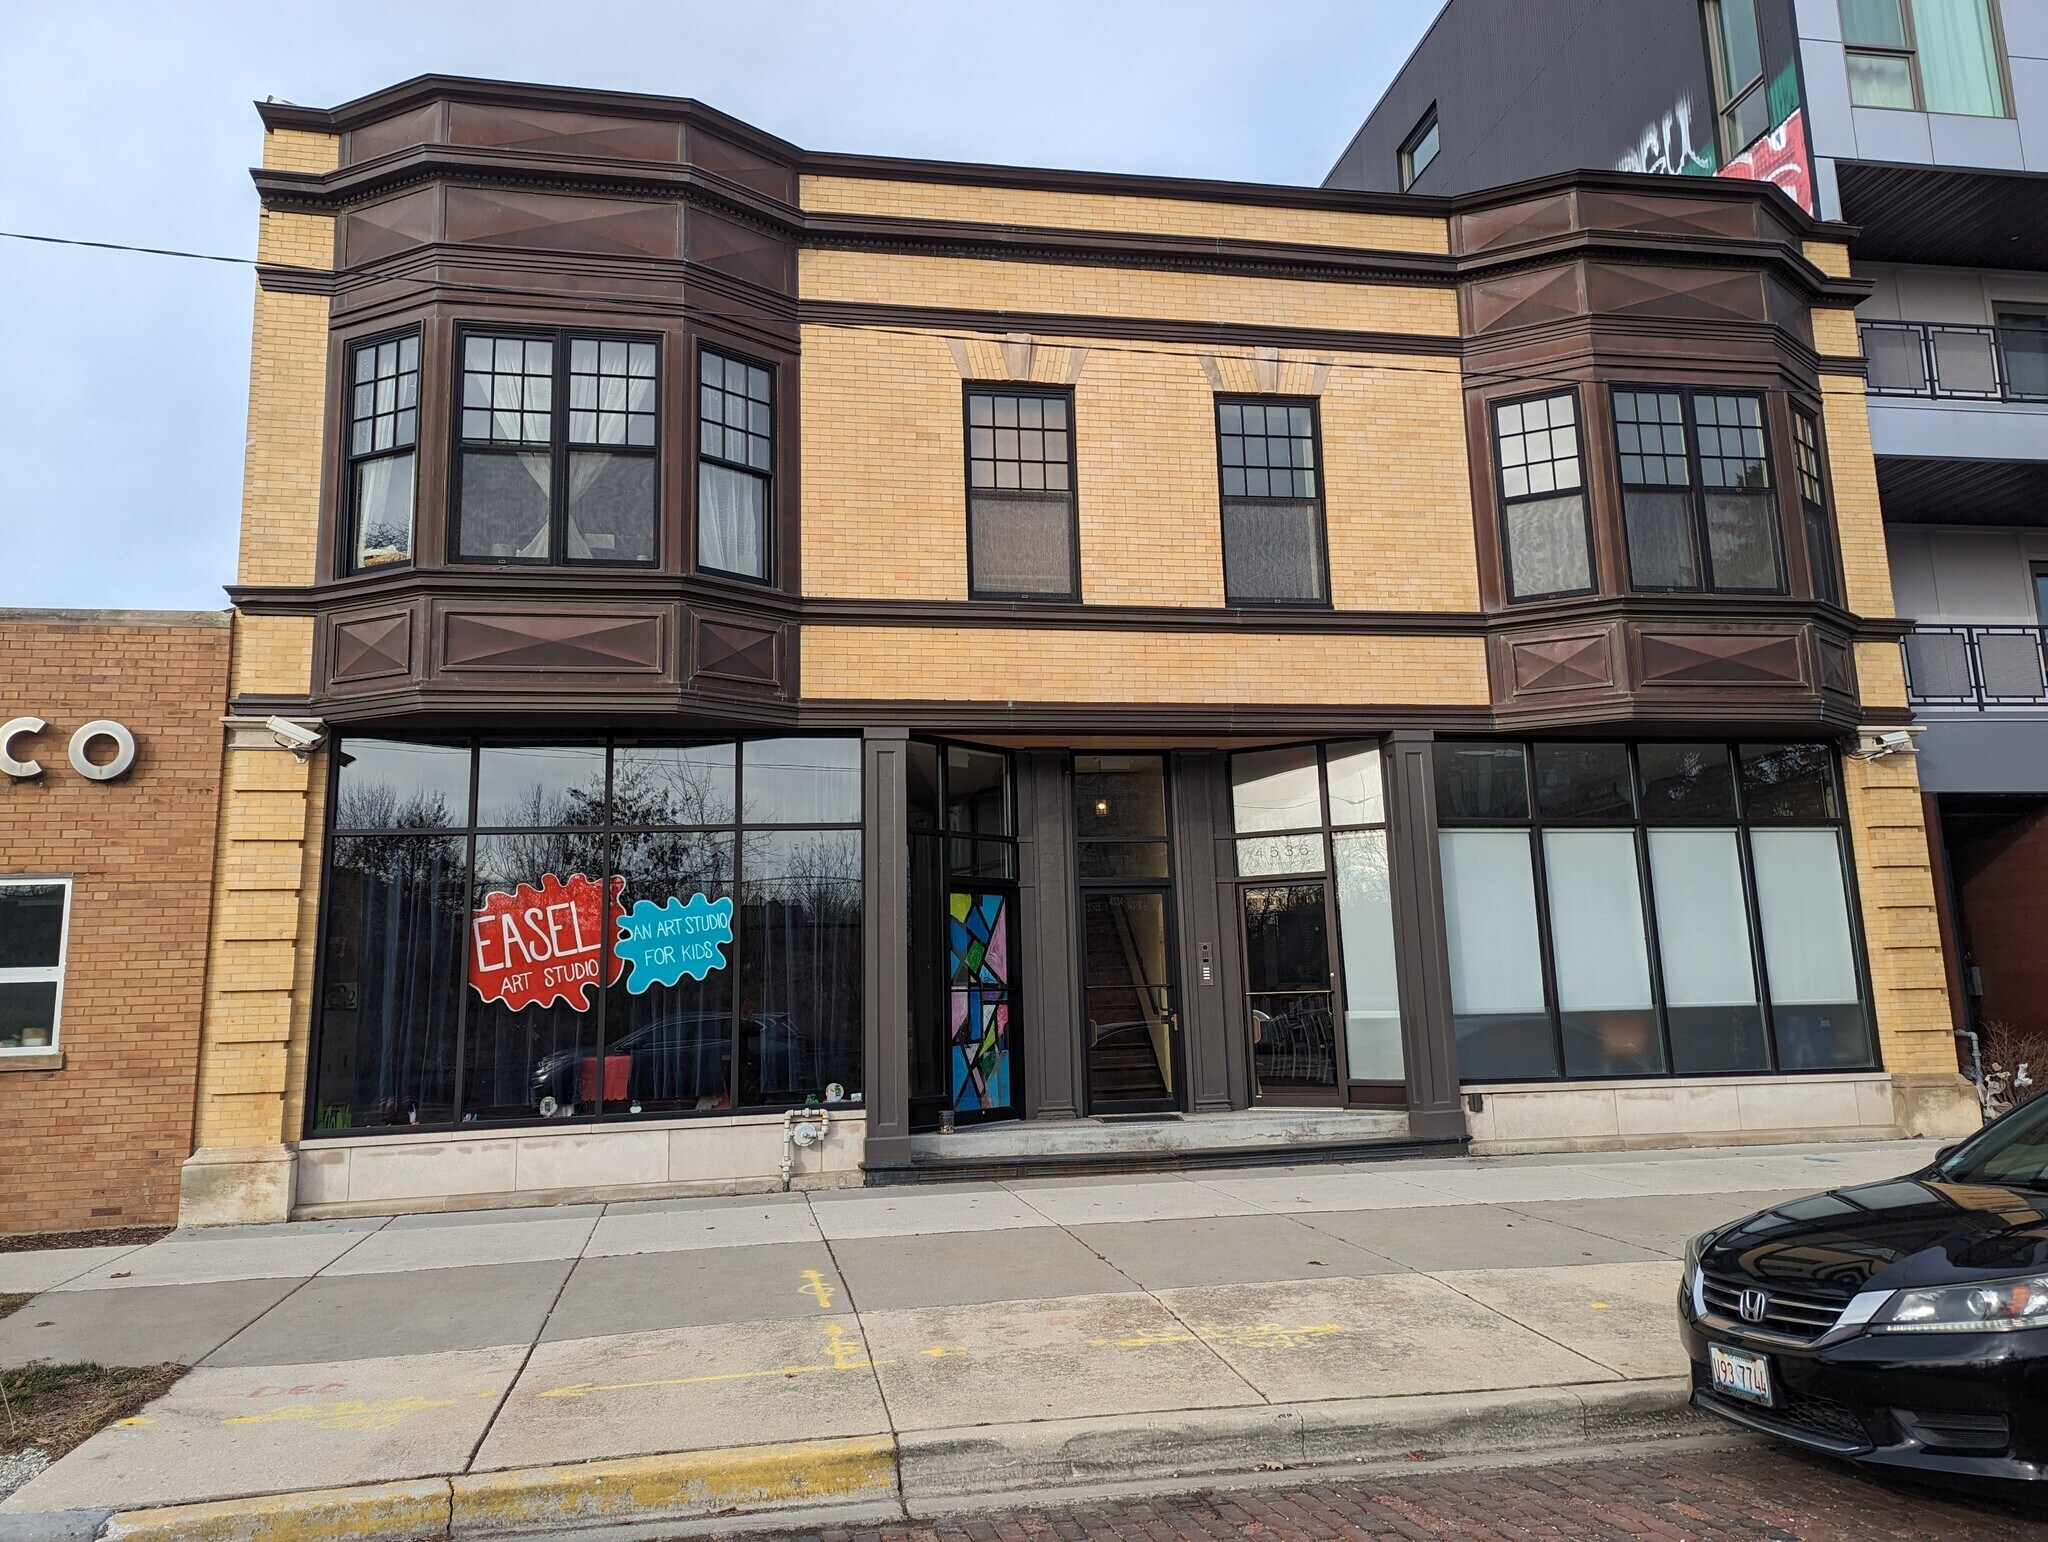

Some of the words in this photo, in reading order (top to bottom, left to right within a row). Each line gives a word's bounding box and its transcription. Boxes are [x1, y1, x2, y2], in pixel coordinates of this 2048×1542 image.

[1254, 844, 1309, 859] 4536
[473, 901, 601, 972] EASEL
[633, 924, 652, 941] AN
[656, 918, 683, 938] ART
[685, 912, 728, 935] STUDIO
[645, 947, 675, 966] FOR
[681, 942, 713, 962] KIDS
[501, 972, 533, 995] ART
[544, 959, 599, 988] STUDIO
